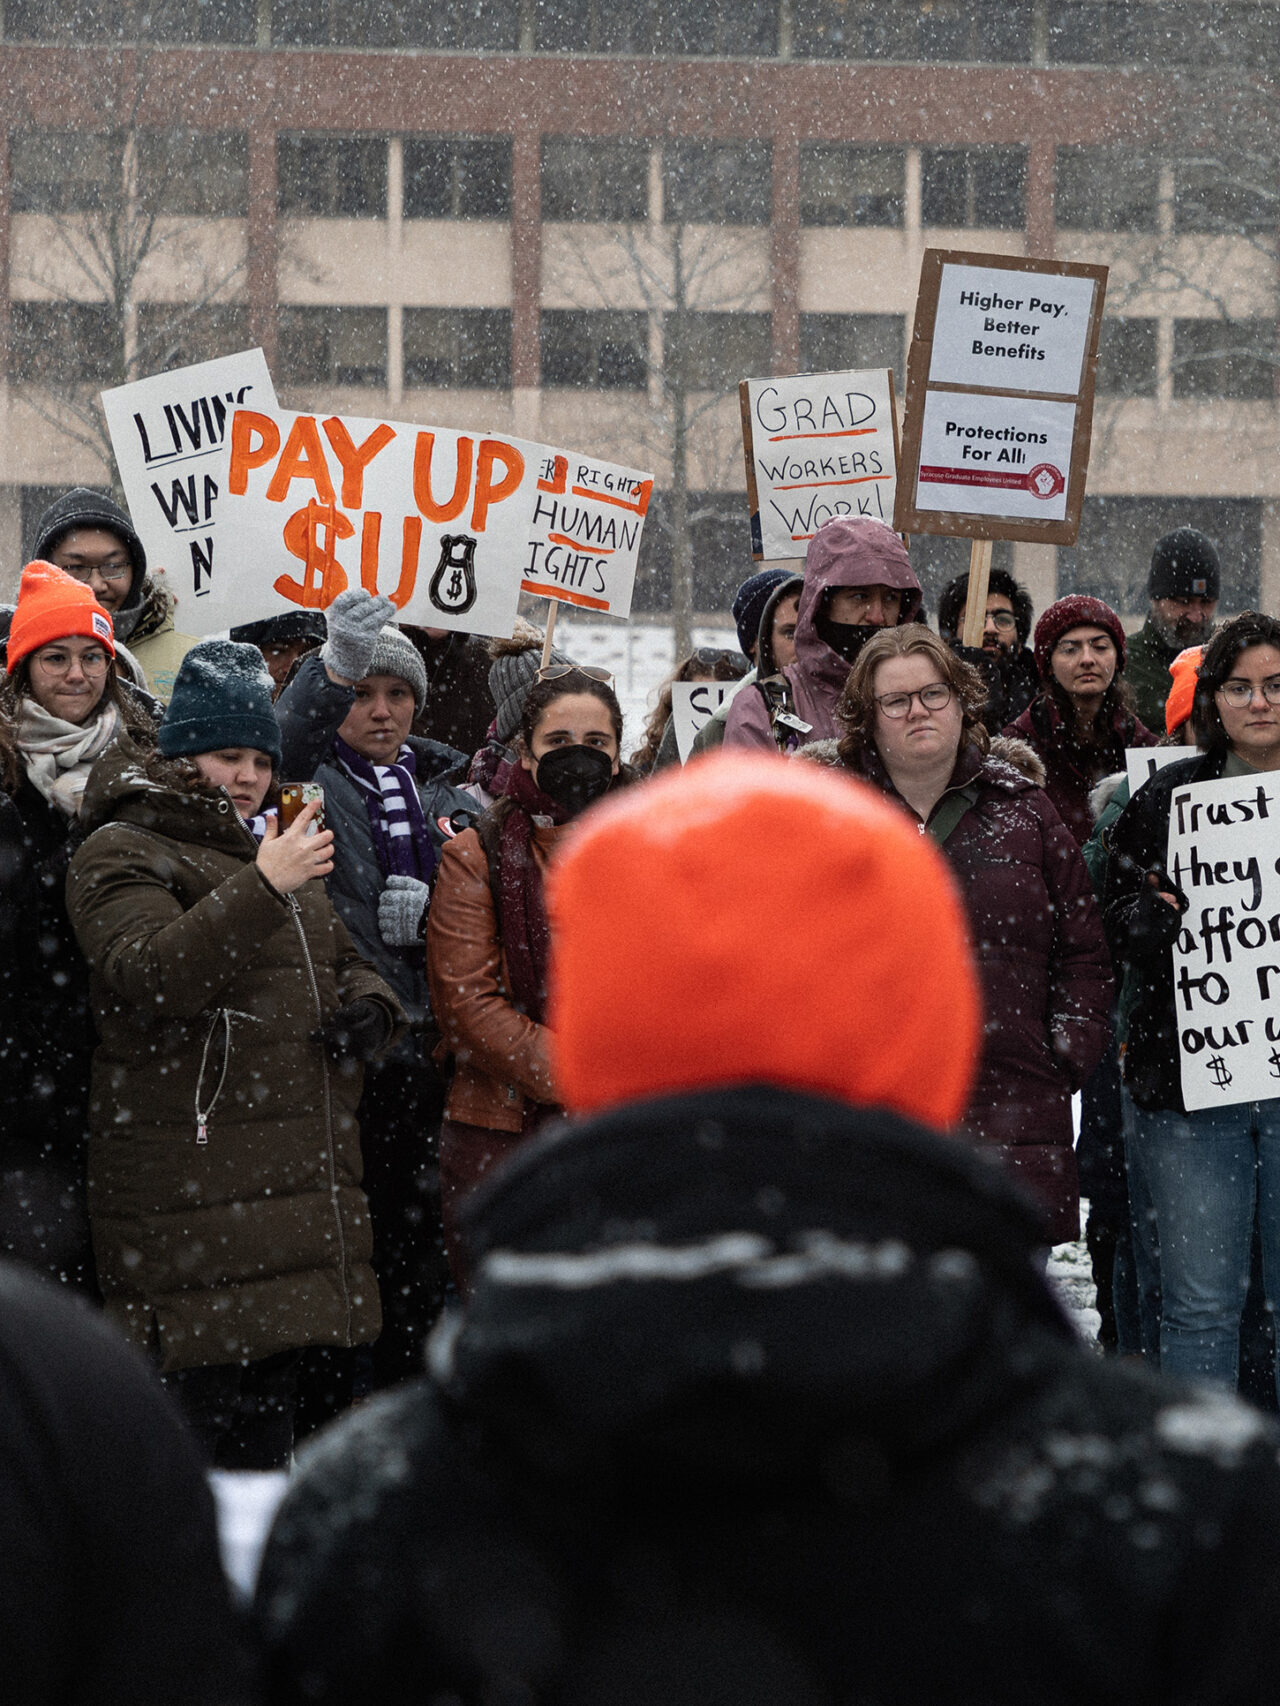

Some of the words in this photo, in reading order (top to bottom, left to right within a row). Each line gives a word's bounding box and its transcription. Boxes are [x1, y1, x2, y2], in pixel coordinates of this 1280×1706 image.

[959, 291, 1024, 311] Higher
[984, 318, 1040, 336] Better
[972, 340, 1046, 361] Benefits
[756, 387, 876, 433] GRAD
[945, 422, 1048, 445] Protections
[228, 409, 397, 510] PAY
[412, 431, 526, 533] UP
[759, 450, 883, 482] WORKERS
[962, 445, 992, 463] For
[576, 466, 643, 496] RIGHTS
[532, 495, 640, 552] HUMAN
[523, 542, 608, 593] IGHTS
[1174, 785, 1275, 836] Trust
[1171, 845, 1263, 912] they
[1177, 965, 1230, 1012] to
[1181, 1018, 1255, 1054] our
[1205, 1053, 1233, 1091] $
